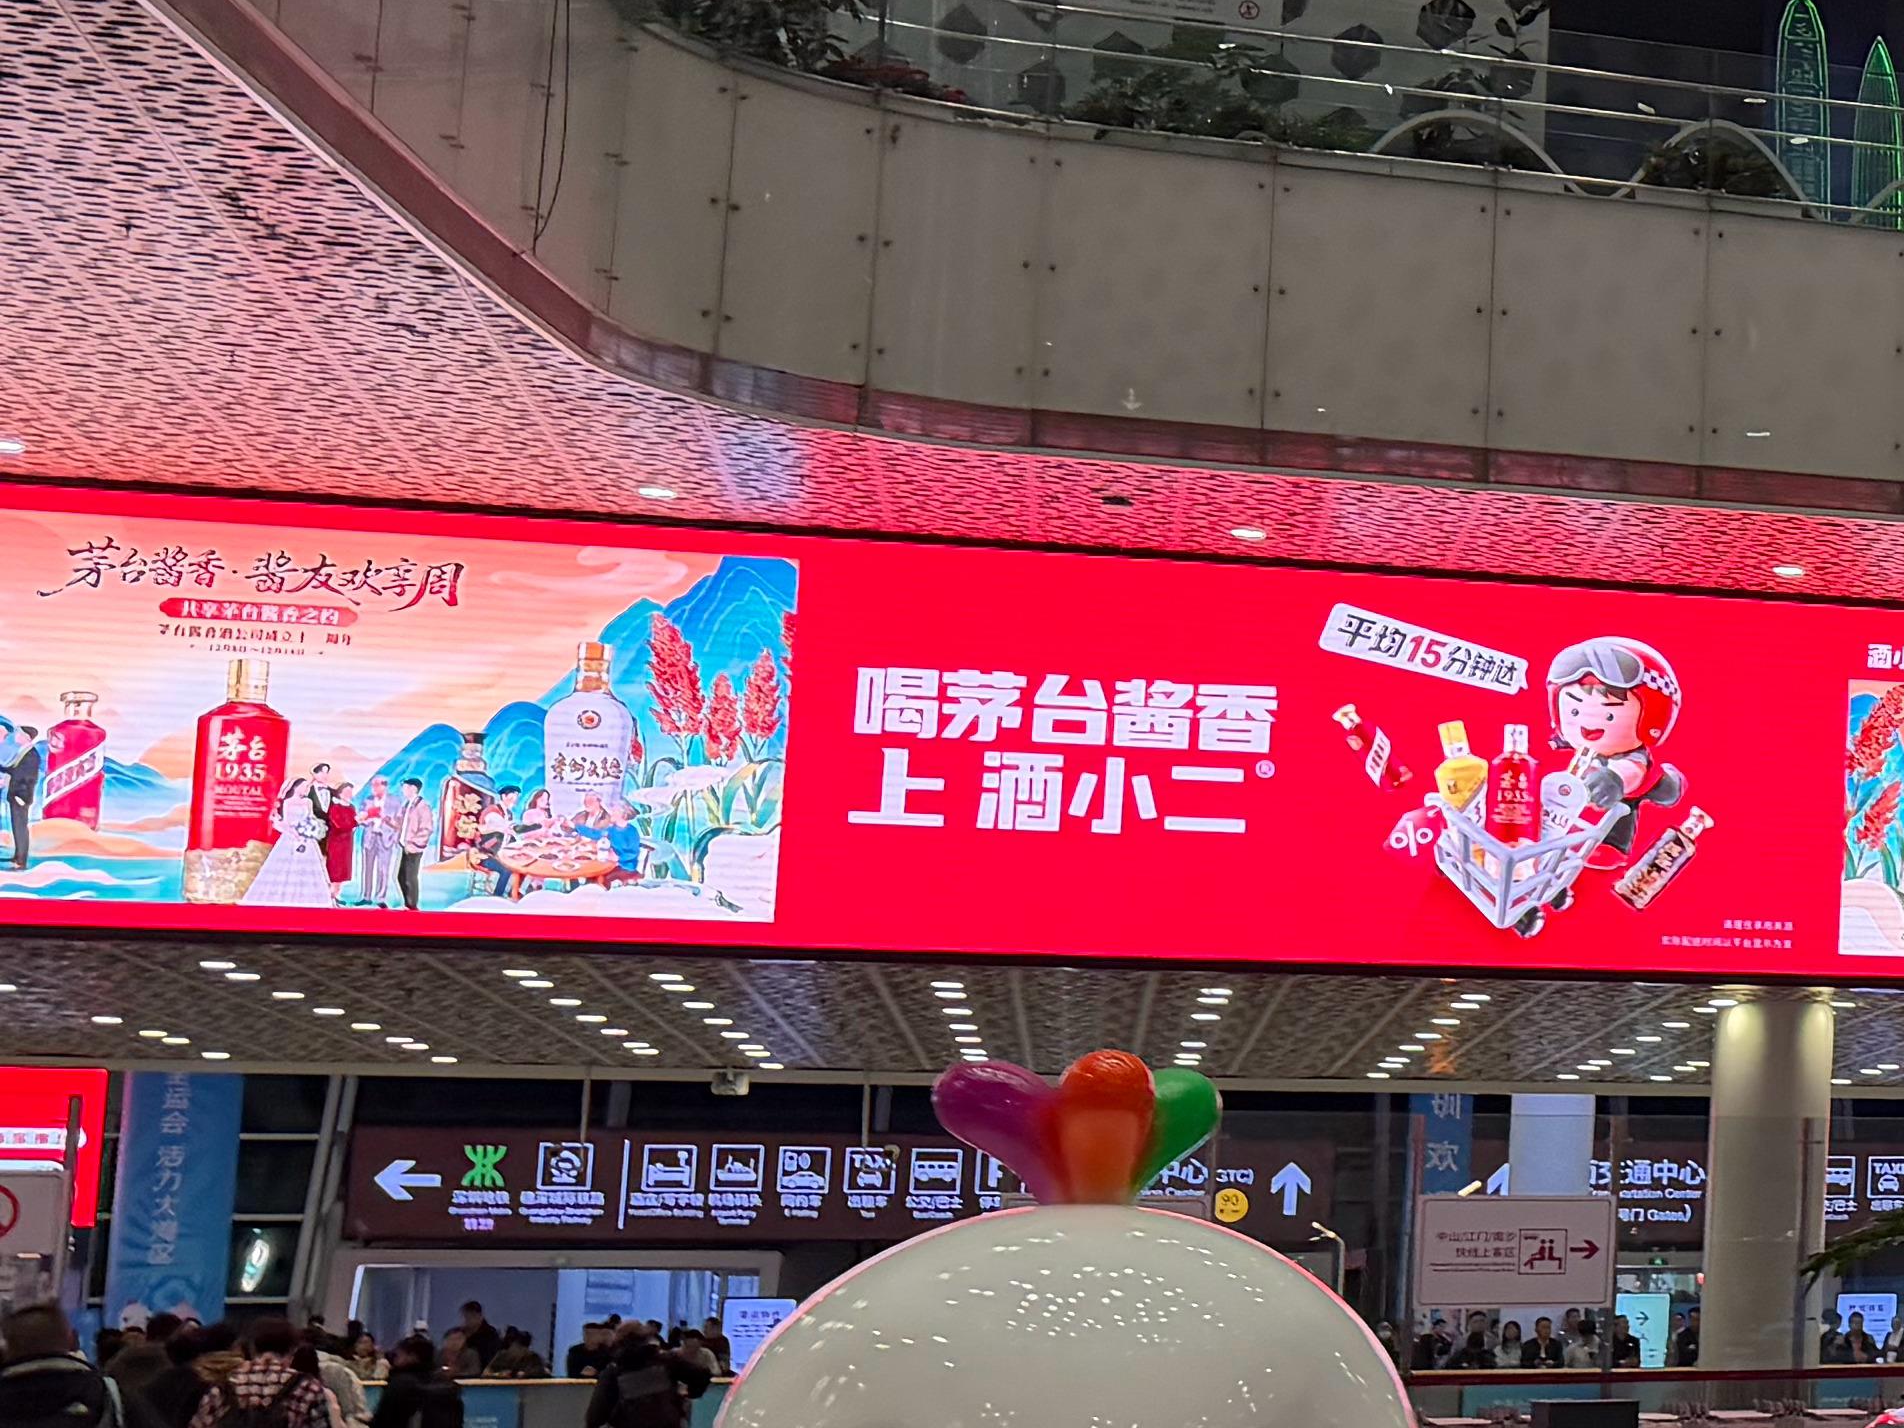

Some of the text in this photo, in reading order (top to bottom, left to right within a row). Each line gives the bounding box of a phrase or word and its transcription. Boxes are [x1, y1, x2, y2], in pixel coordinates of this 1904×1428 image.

[1337, 613, 1518, 688] 平均15分钟达
[854, 667, 1278, 753] 喝茅台酱香
[215, 763, 266, 782] 1935
[848, 748, 944, 827] 上
